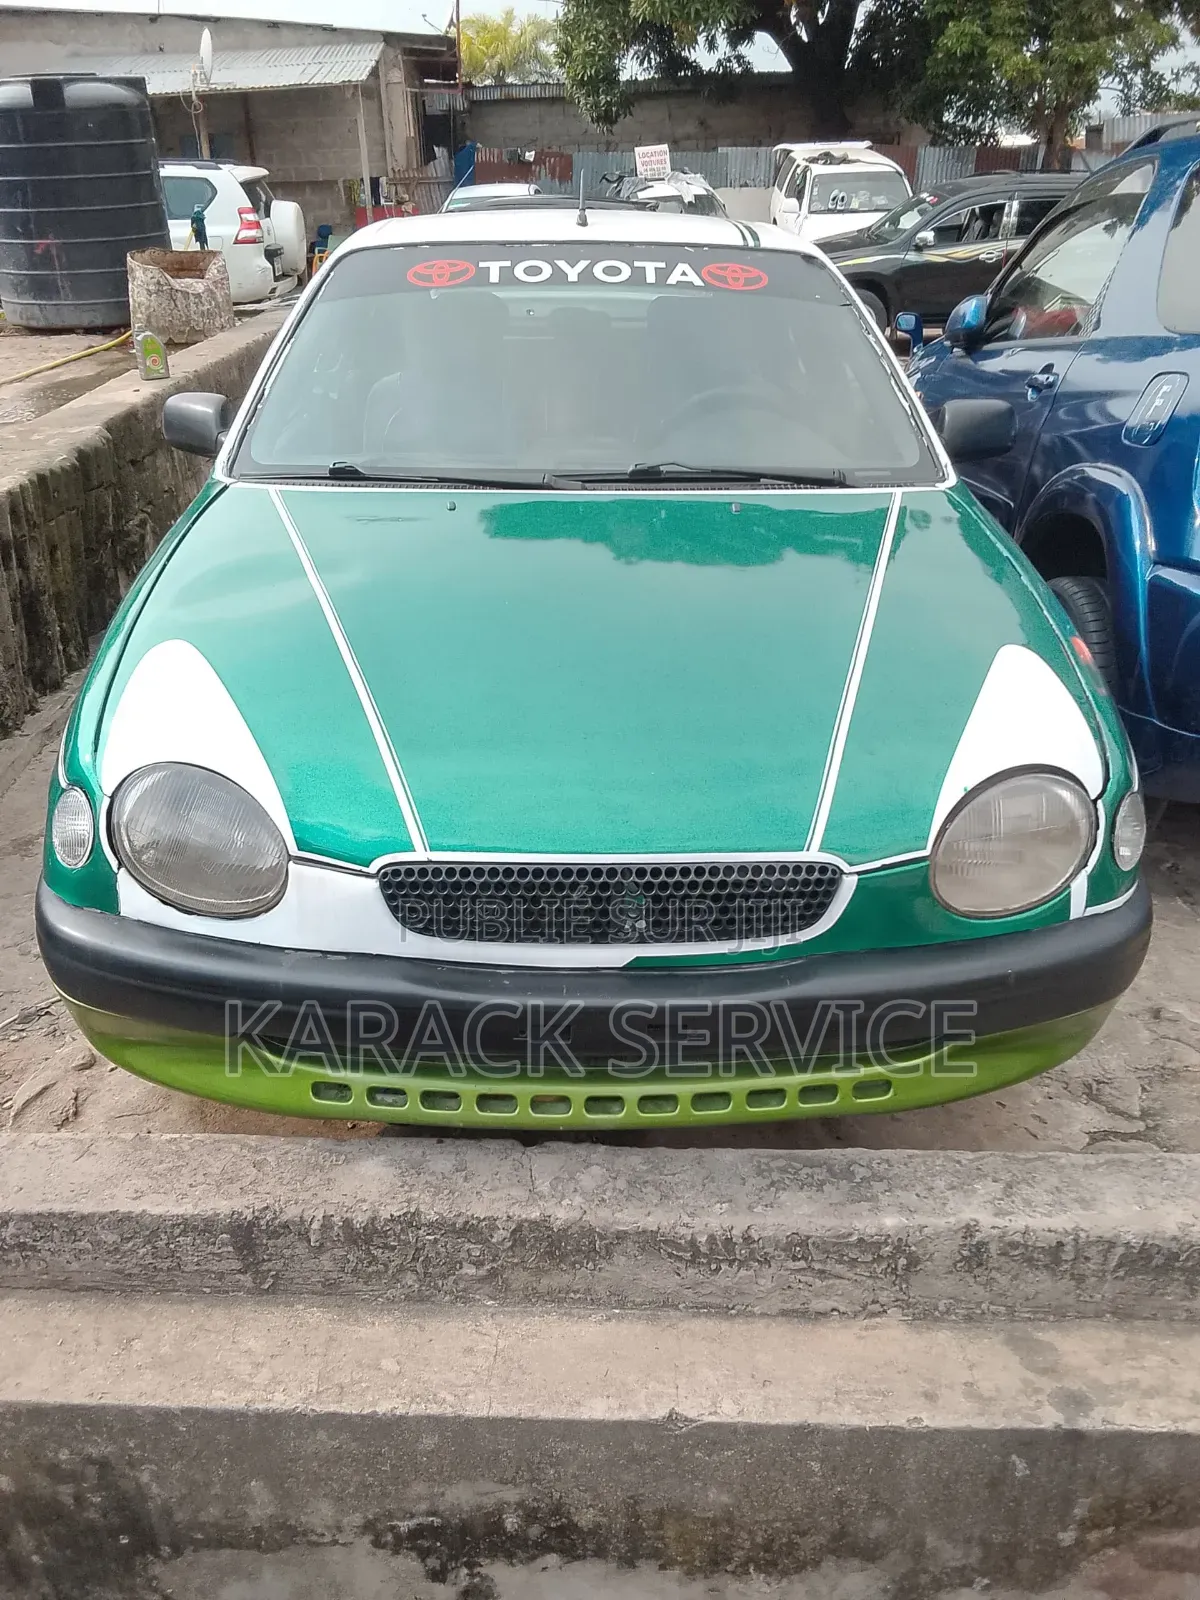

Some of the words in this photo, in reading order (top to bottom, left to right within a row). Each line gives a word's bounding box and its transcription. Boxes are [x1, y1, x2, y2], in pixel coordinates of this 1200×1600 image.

[637, 149, 668, 159] LOCATION
[640, 158, 667, 167] VOITURES
[479, 260, 705, 286] TOYOTA
